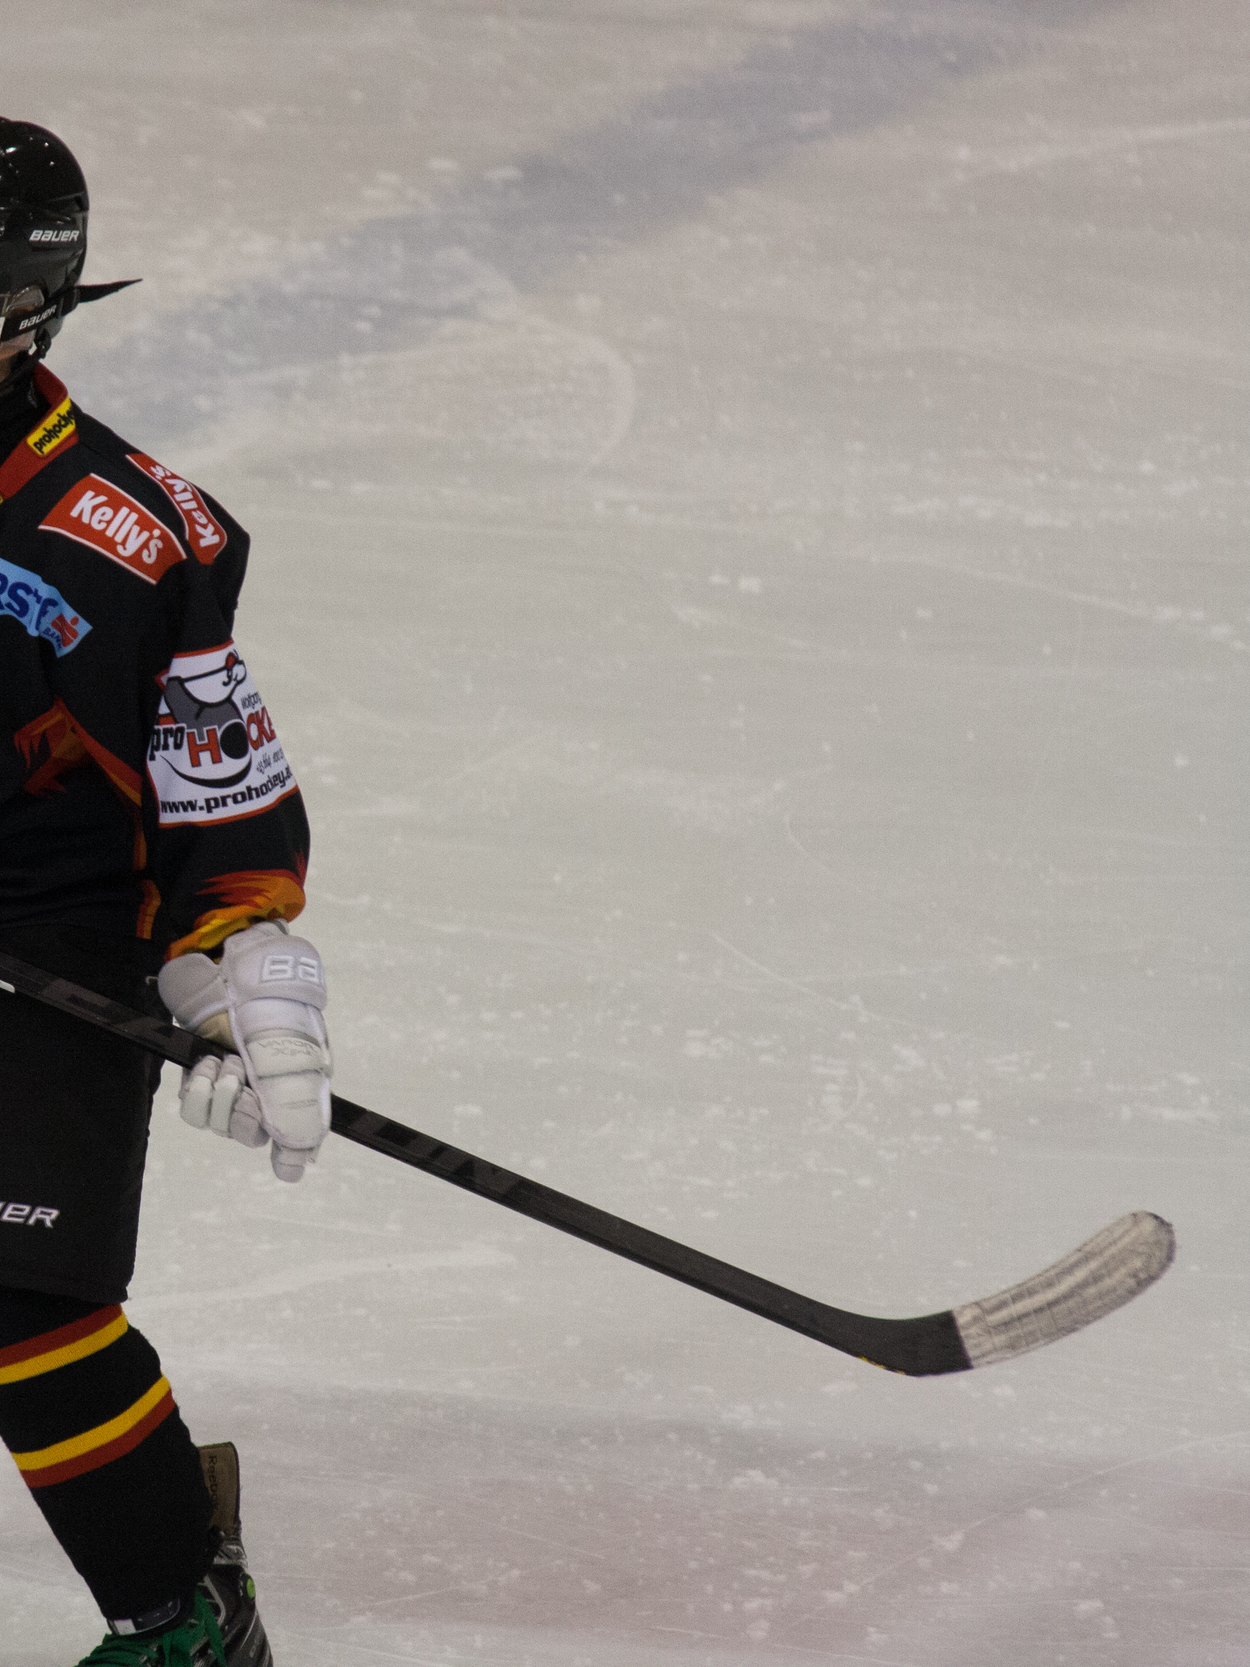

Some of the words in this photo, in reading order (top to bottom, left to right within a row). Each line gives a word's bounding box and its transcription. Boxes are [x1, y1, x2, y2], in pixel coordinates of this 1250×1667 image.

[29, 229, 80, 242] BAUER
[18, 304, 57, 331] BAUER
[70, 489, 163, 564] Kelly's
